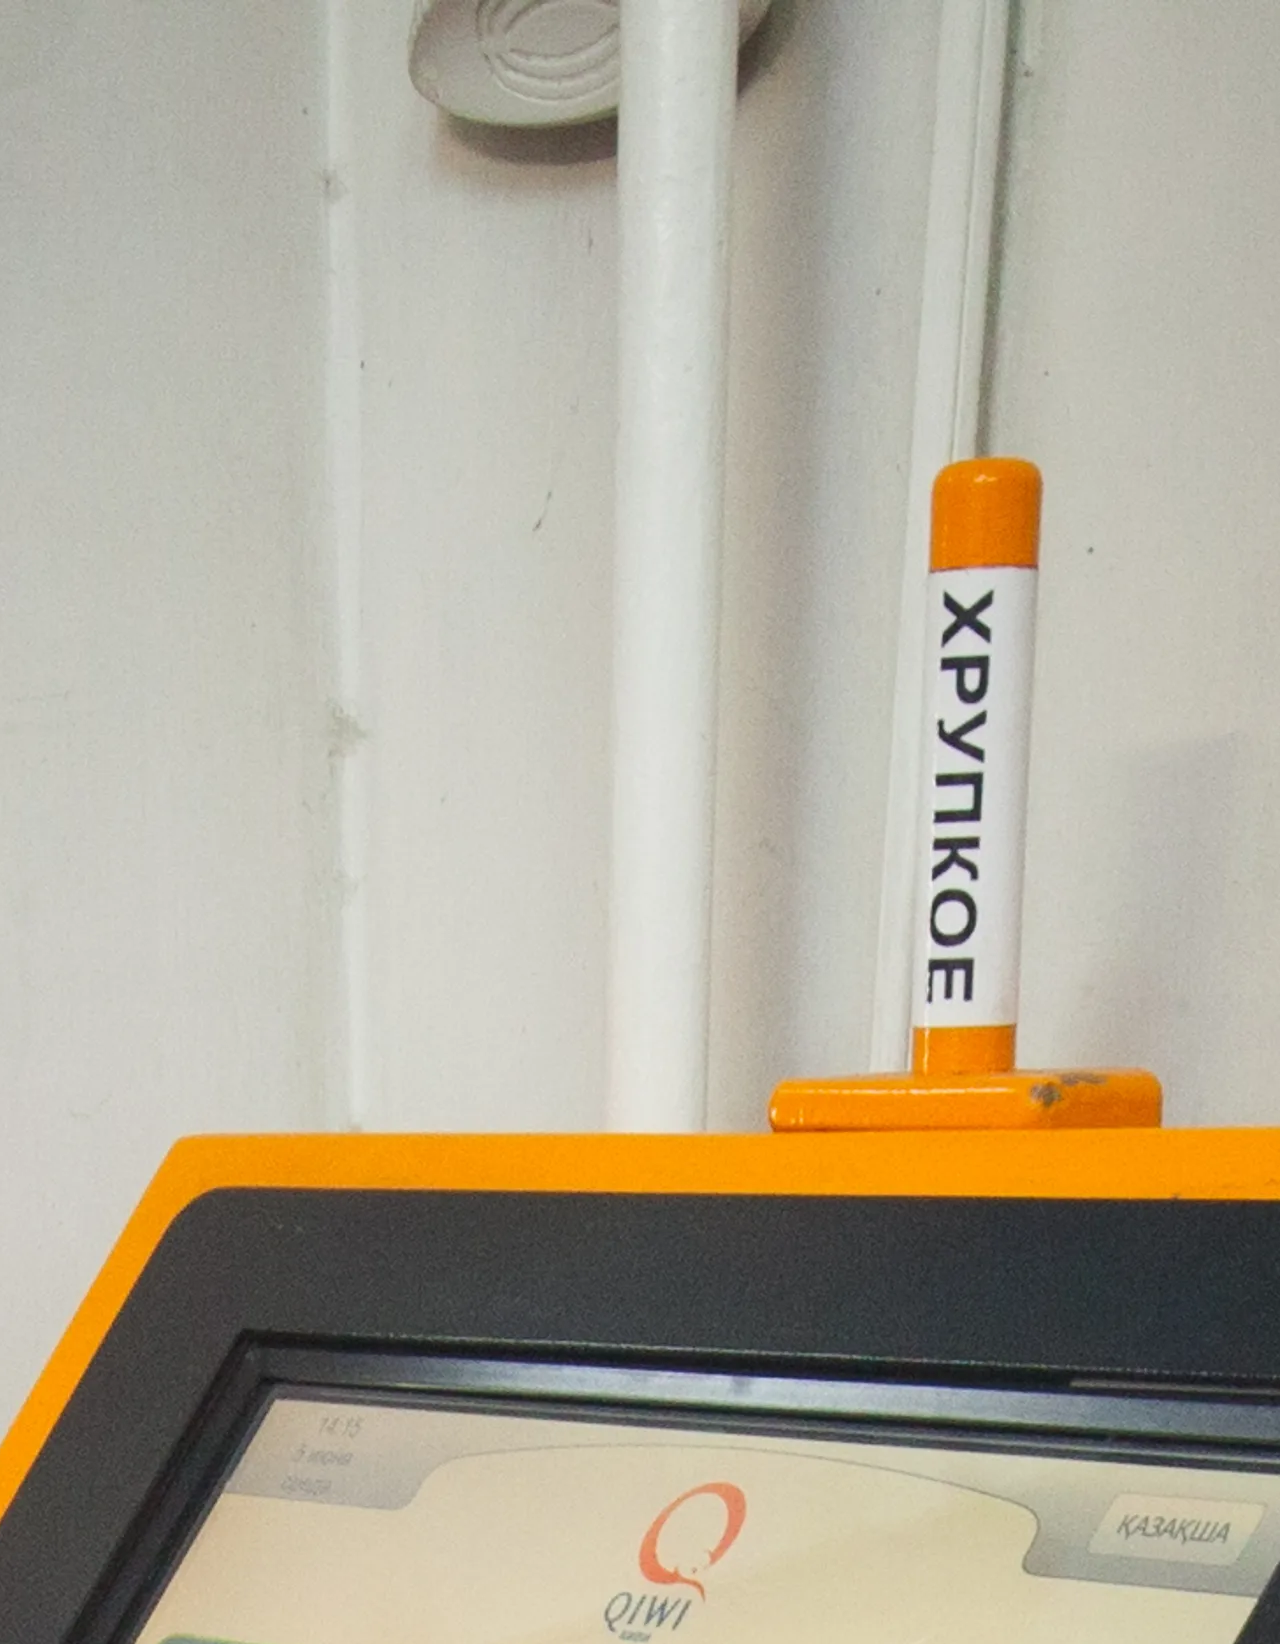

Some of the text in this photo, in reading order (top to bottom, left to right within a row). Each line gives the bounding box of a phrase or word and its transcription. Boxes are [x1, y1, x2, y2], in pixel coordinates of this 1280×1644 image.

[927, 588, 995, 1004] ХРУПКОЕ
[1116, 1513, 1232, 1546] ҚАЗАҚША
[603, 1591, 693, 1633] QIWI
